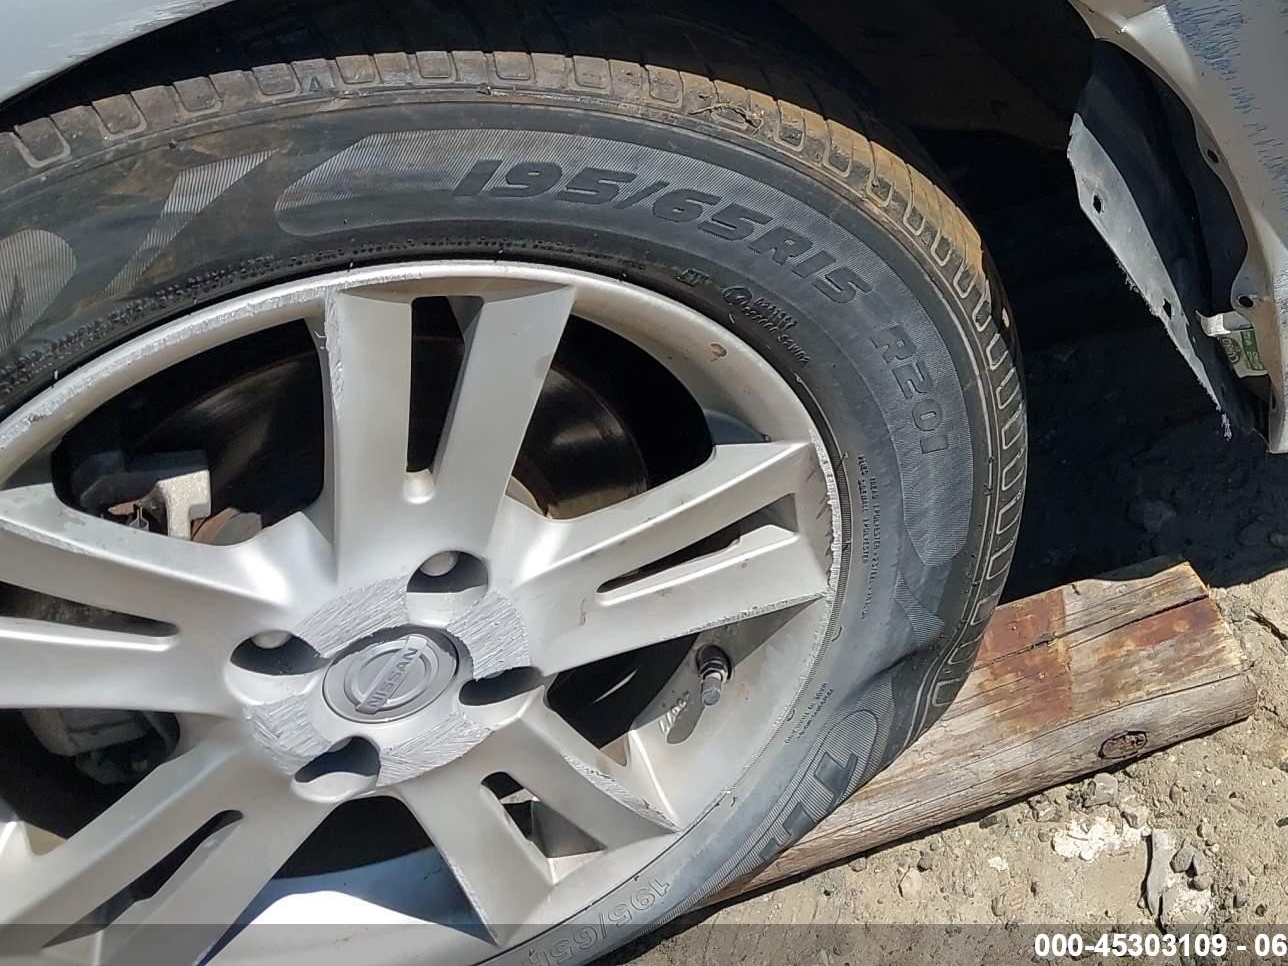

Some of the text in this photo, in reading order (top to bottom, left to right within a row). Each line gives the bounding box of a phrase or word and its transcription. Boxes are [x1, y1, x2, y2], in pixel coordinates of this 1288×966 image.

[451, 159, 875, 304] 195/65R15
[870, 322, 949, 454] R201
[366, 647, 419, 709] NISSAN
